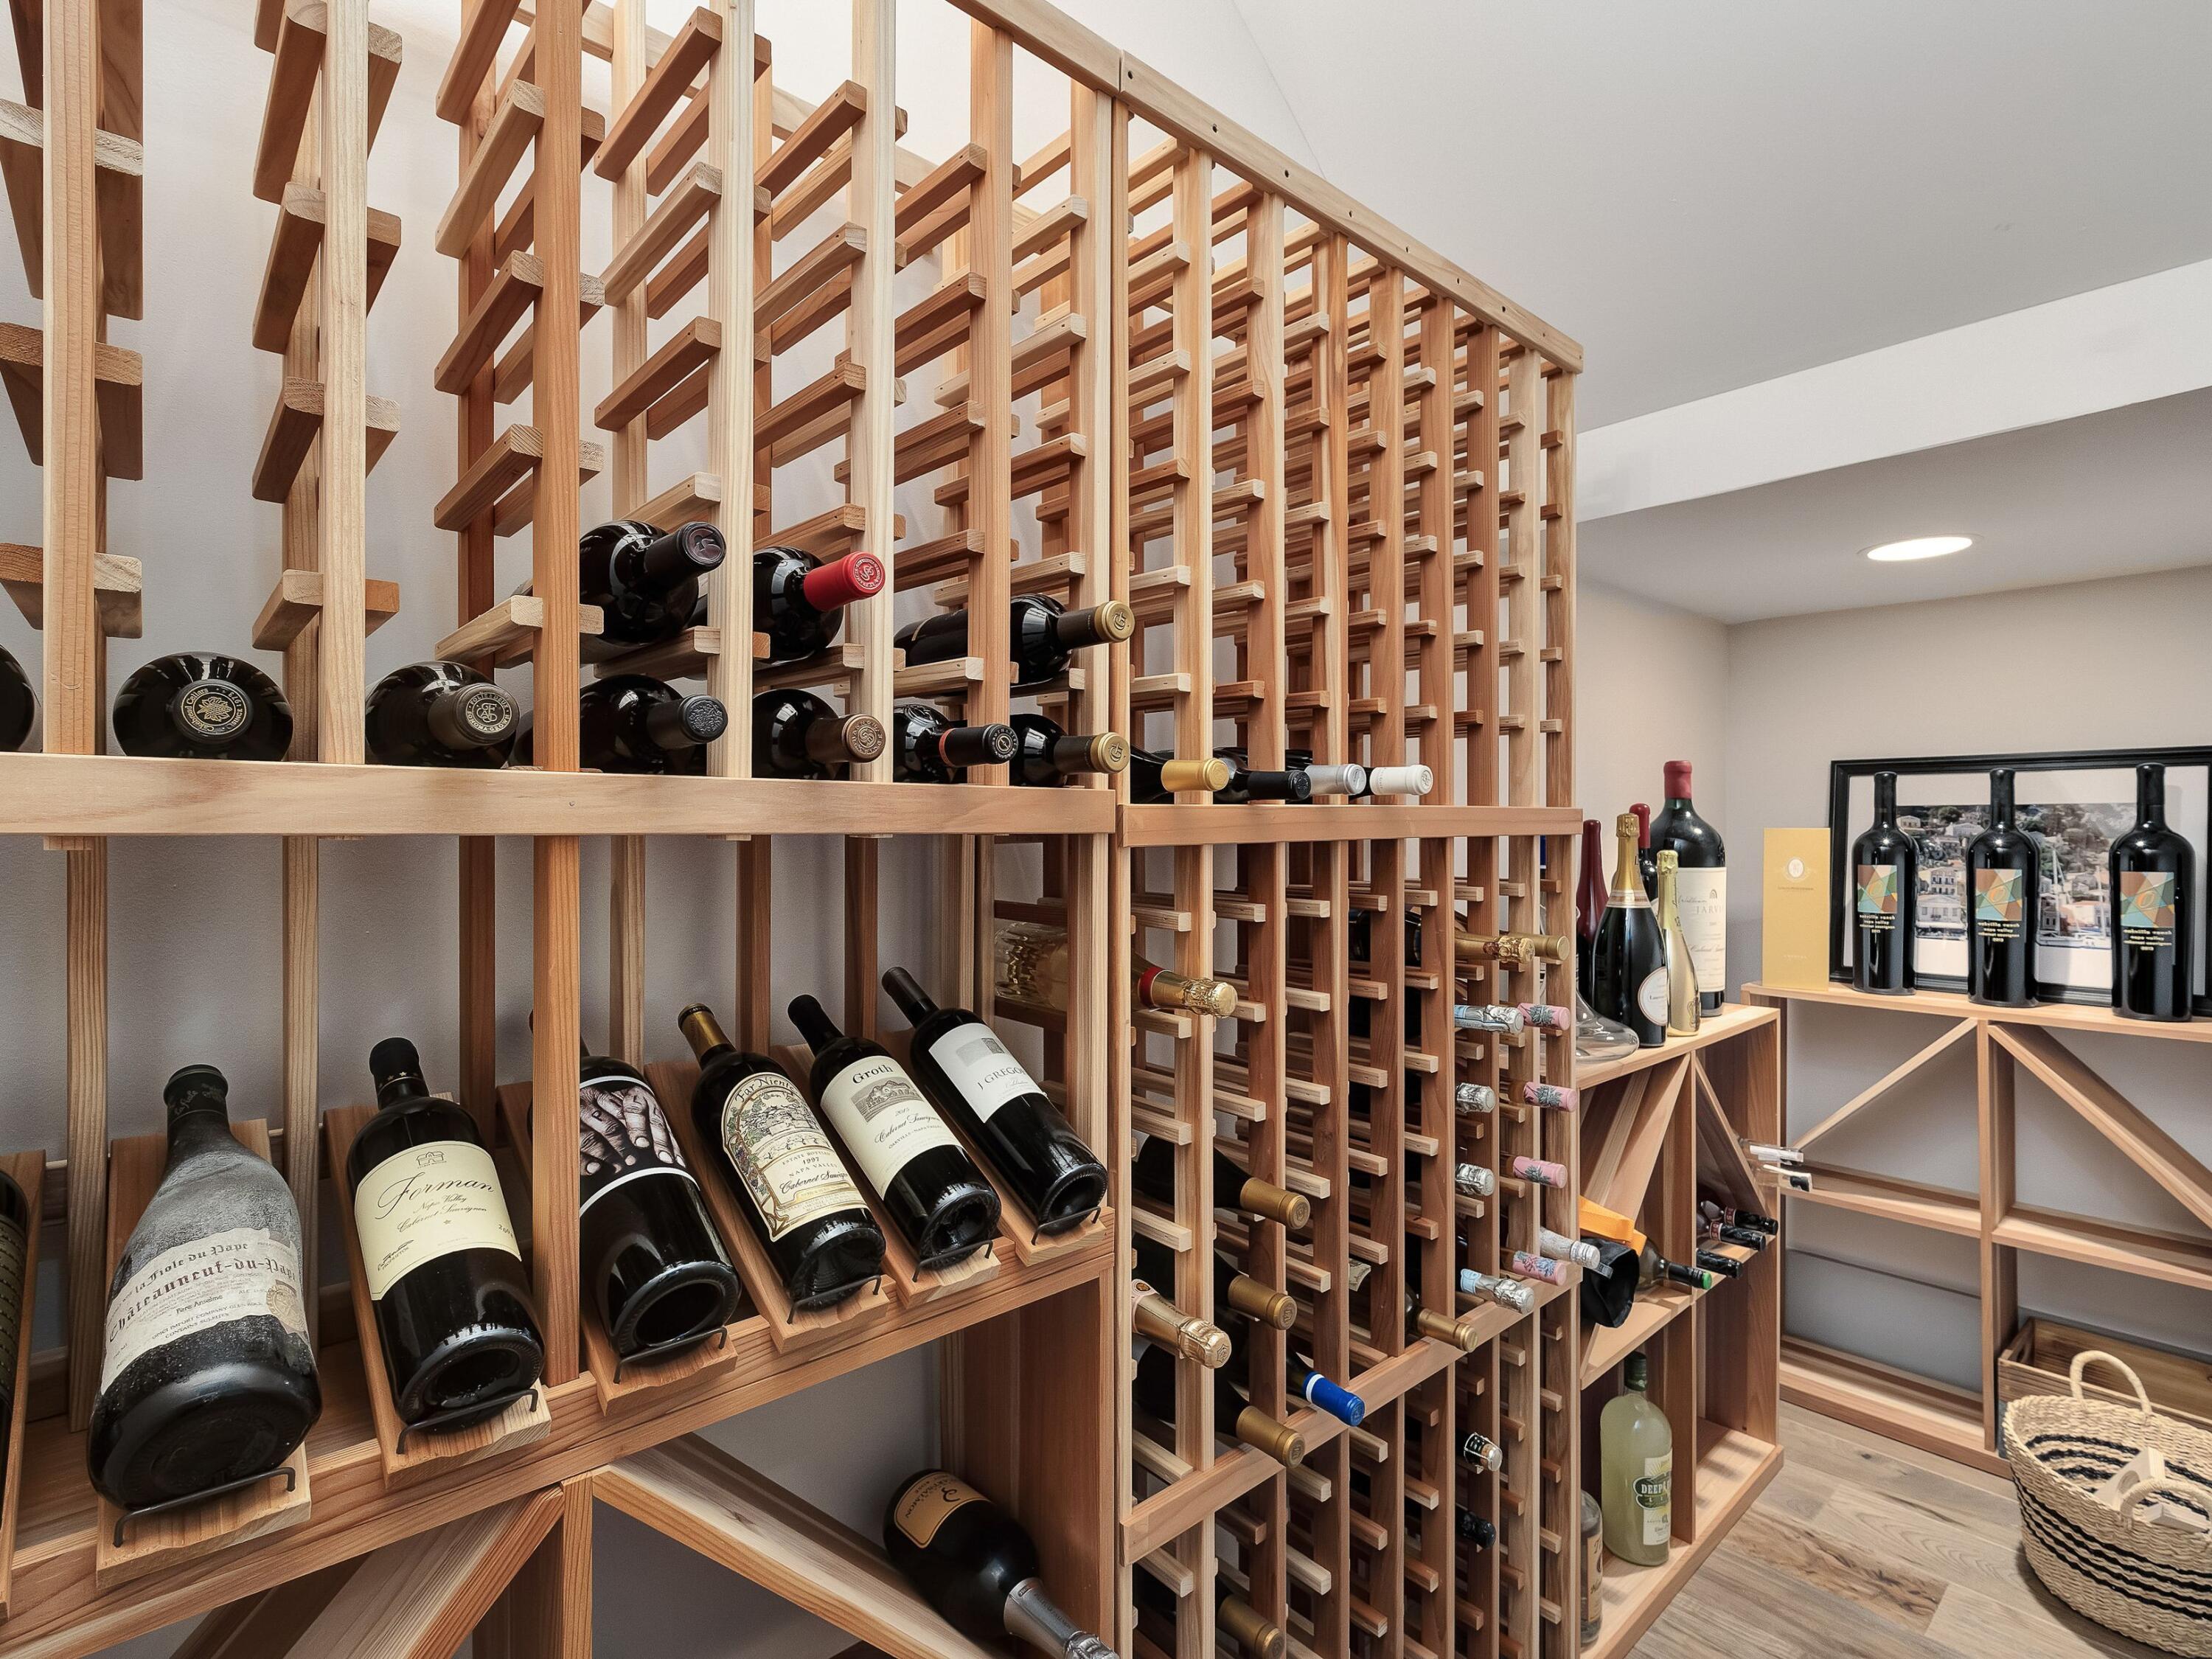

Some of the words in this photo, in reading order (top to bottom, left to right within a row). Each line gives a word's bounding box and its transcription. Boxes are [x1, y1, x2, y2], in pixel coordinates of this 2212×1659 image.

[187, 689, 209, 705] Cellars
[229, 692, 242, 707] 1973
[185, 706, 215, 731] Cakebread
[467, 711, 488, 731] SONOMA
[852, 1064, 894, 1084] Groth
[735, 1082, 755, 1102] Far
[755, 1077, 794, 1091] Niente
[874, 1120, 907, 1144] Cabernet
[802, 1156, 820, 1165] 1997
[789, 1166, 810, 1178] NAPA
[779, 1176, 819, 1194] Cabernet
[375, 1172, 494, 1220] Forman
[413, 1200, 440, 1214] Napa
[442, 1194, 467, 1203] Valley
[397, 1211, 438, 1233] Cabernet
[440, 1203, 487, 1215] Sauvignon
[188, 1251, 206, 1262] du
[210, 1242, 248, 1256] Pape
[165, 1321, 199, 1338] CONTAINS
[200, 1312, 229, 1324] SULFITES
[170, 1316, 194, 1332] IMPORT
[195, 1306, 228, 1318] COMPANY
[1641, 1484, 1663, 1495] DEEP
